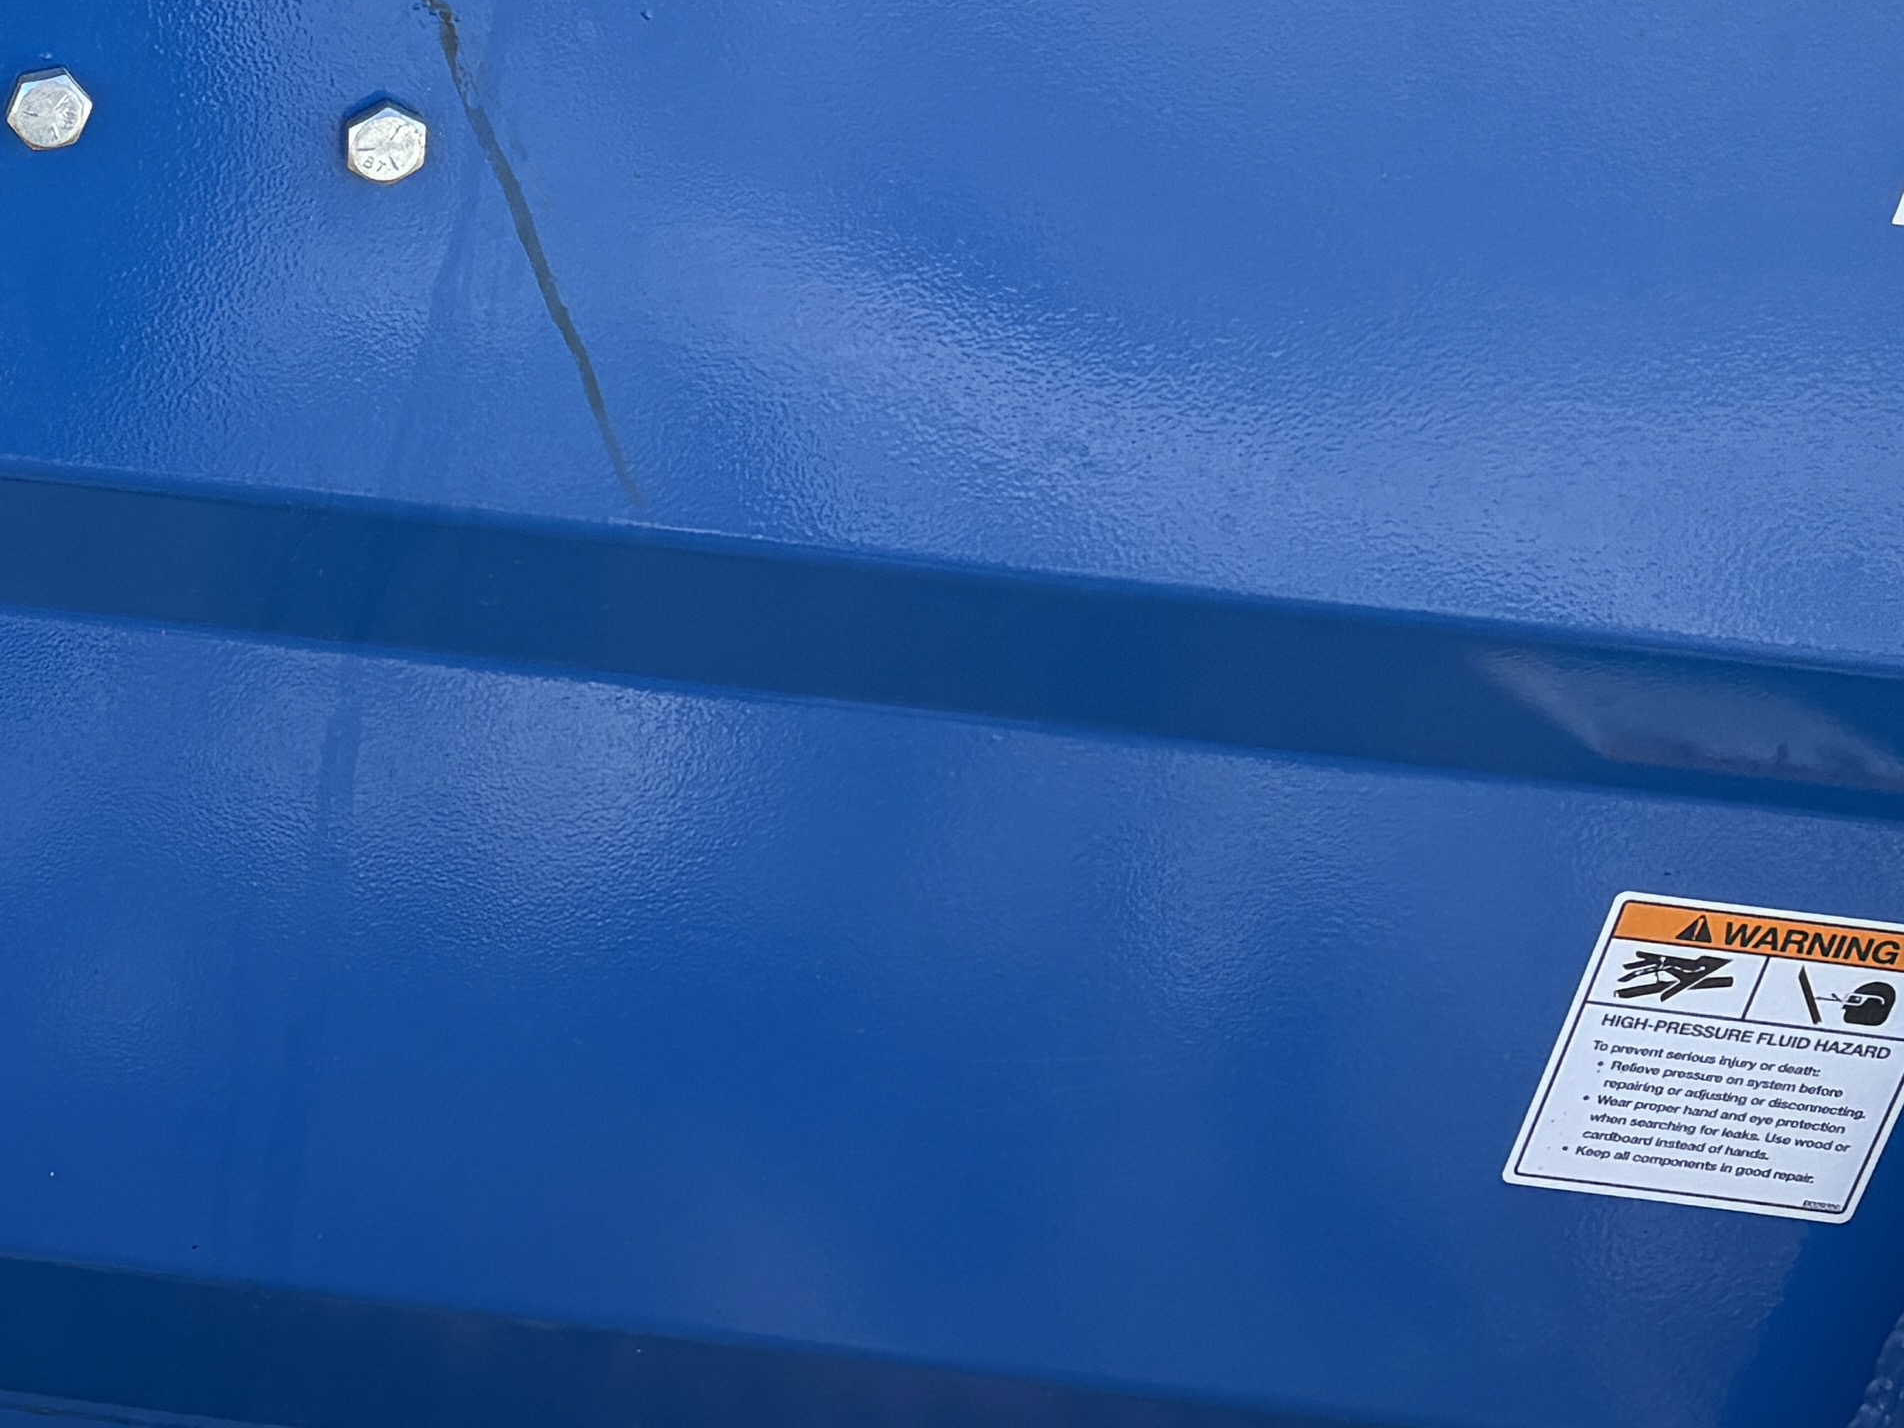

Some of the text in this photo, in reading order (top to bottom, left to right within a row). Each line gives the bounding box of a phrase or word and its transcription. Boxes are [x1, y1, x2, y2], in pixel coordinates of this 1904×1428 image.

[1725, 922, 1901, 965] WARNING
[1601, 1014, 1891, 1059] HIGH-PRESSURE FLUID HAZARD
[1594, 1040, 1820, 1077] To prevent serious injury or death:
[1610, 1060, 1843, 1098] Relieve pressure on system before
[1597, 1094, 1846, 1134] Wear proper hand and eye protection
[1604, 1079, 1866, 1120] repairing or adjusting or disconnecting.
[1582, 1130, 1769, 1160] cardboard instead of hands.
[1590, 1113, 1851, 1152] when searching for leaks. Use wood or
[1575, 1145, 1814, 1184] Keep all components in good repair.
